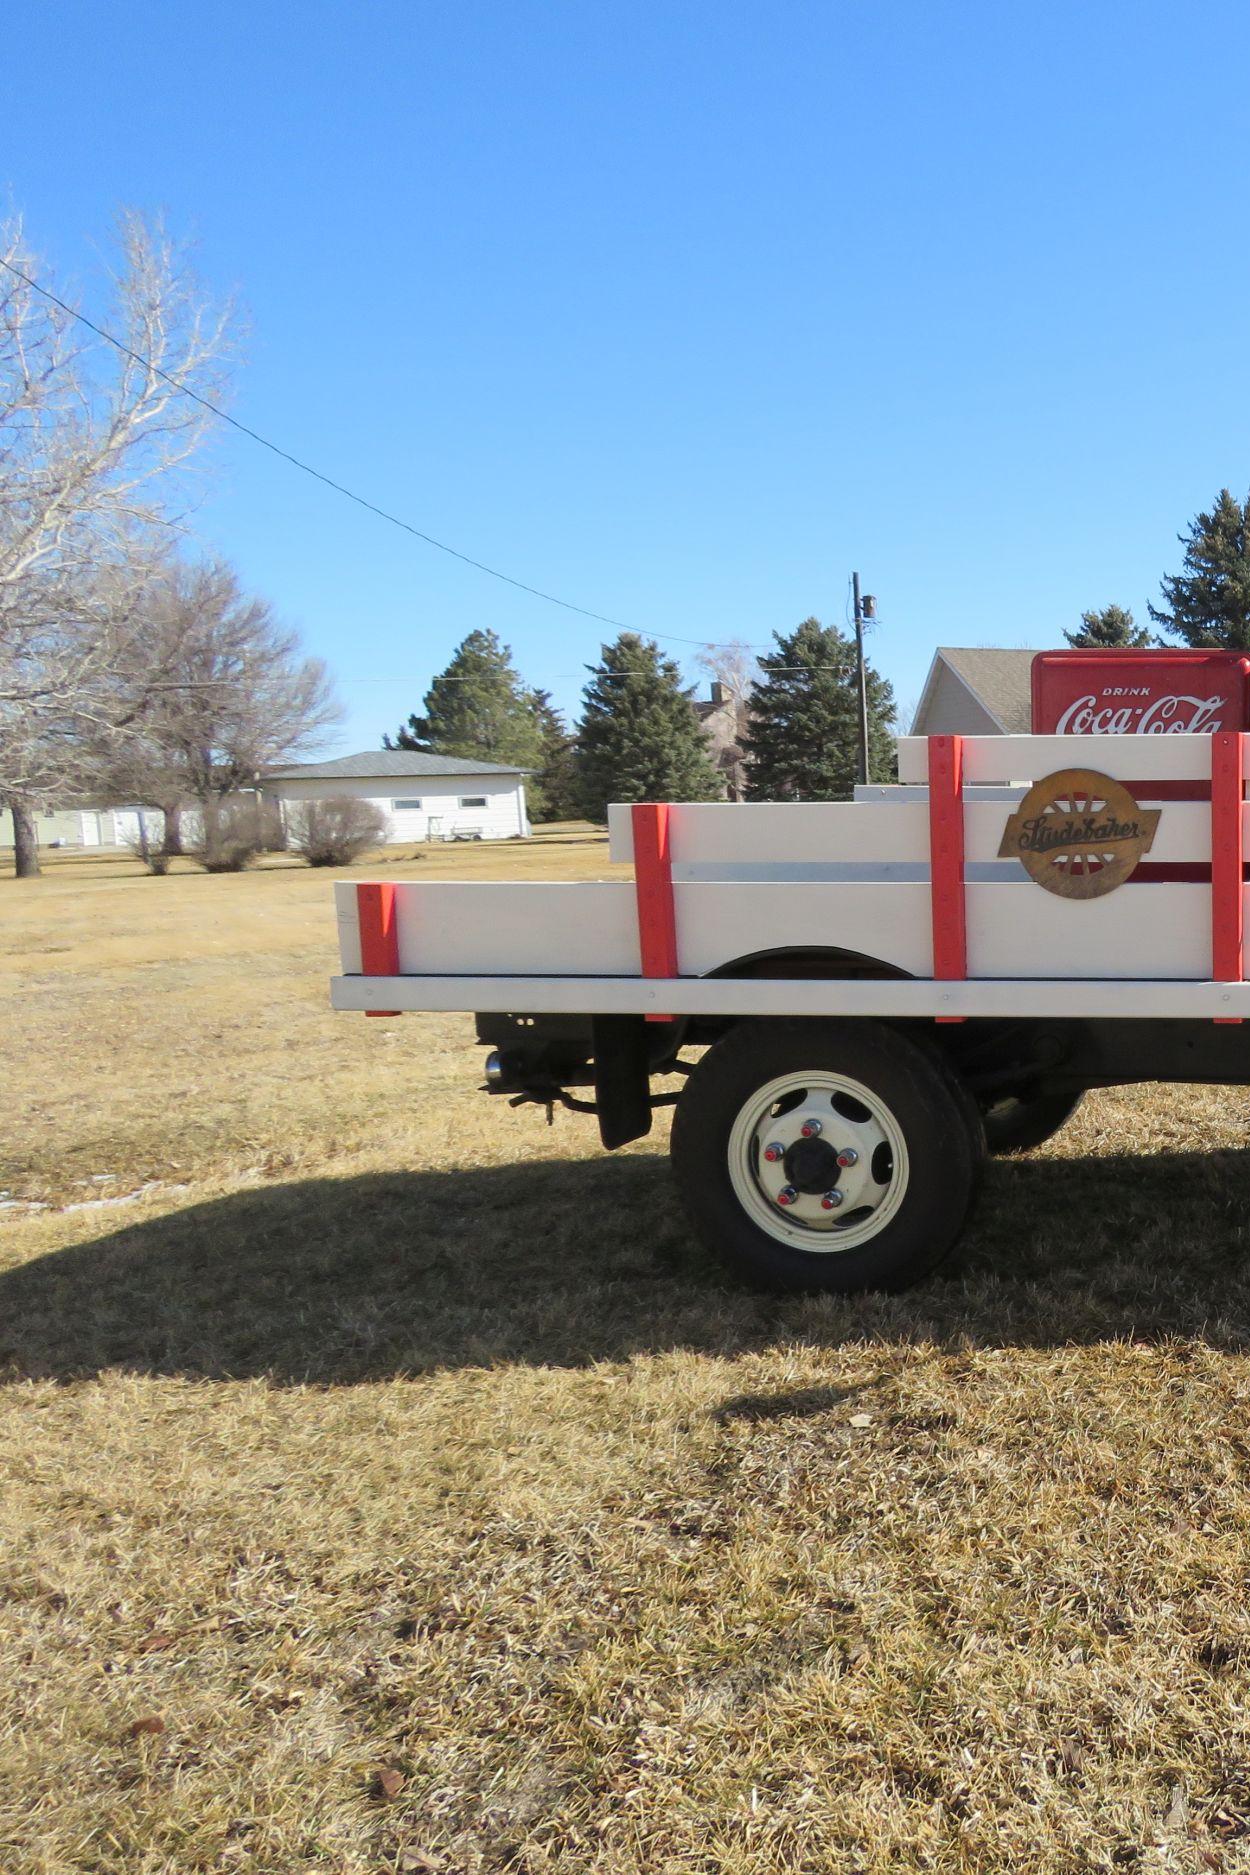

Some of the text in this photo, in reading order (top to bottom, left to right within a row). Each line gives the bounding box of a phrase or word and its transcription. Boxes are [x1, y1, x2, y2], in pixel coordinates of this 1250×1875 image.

[1102, 687, 1151, 696] DRINK
[1055, 694, 1228, 735] Coca-Cola
[1018, 814, 1142, 853] Studebaker
